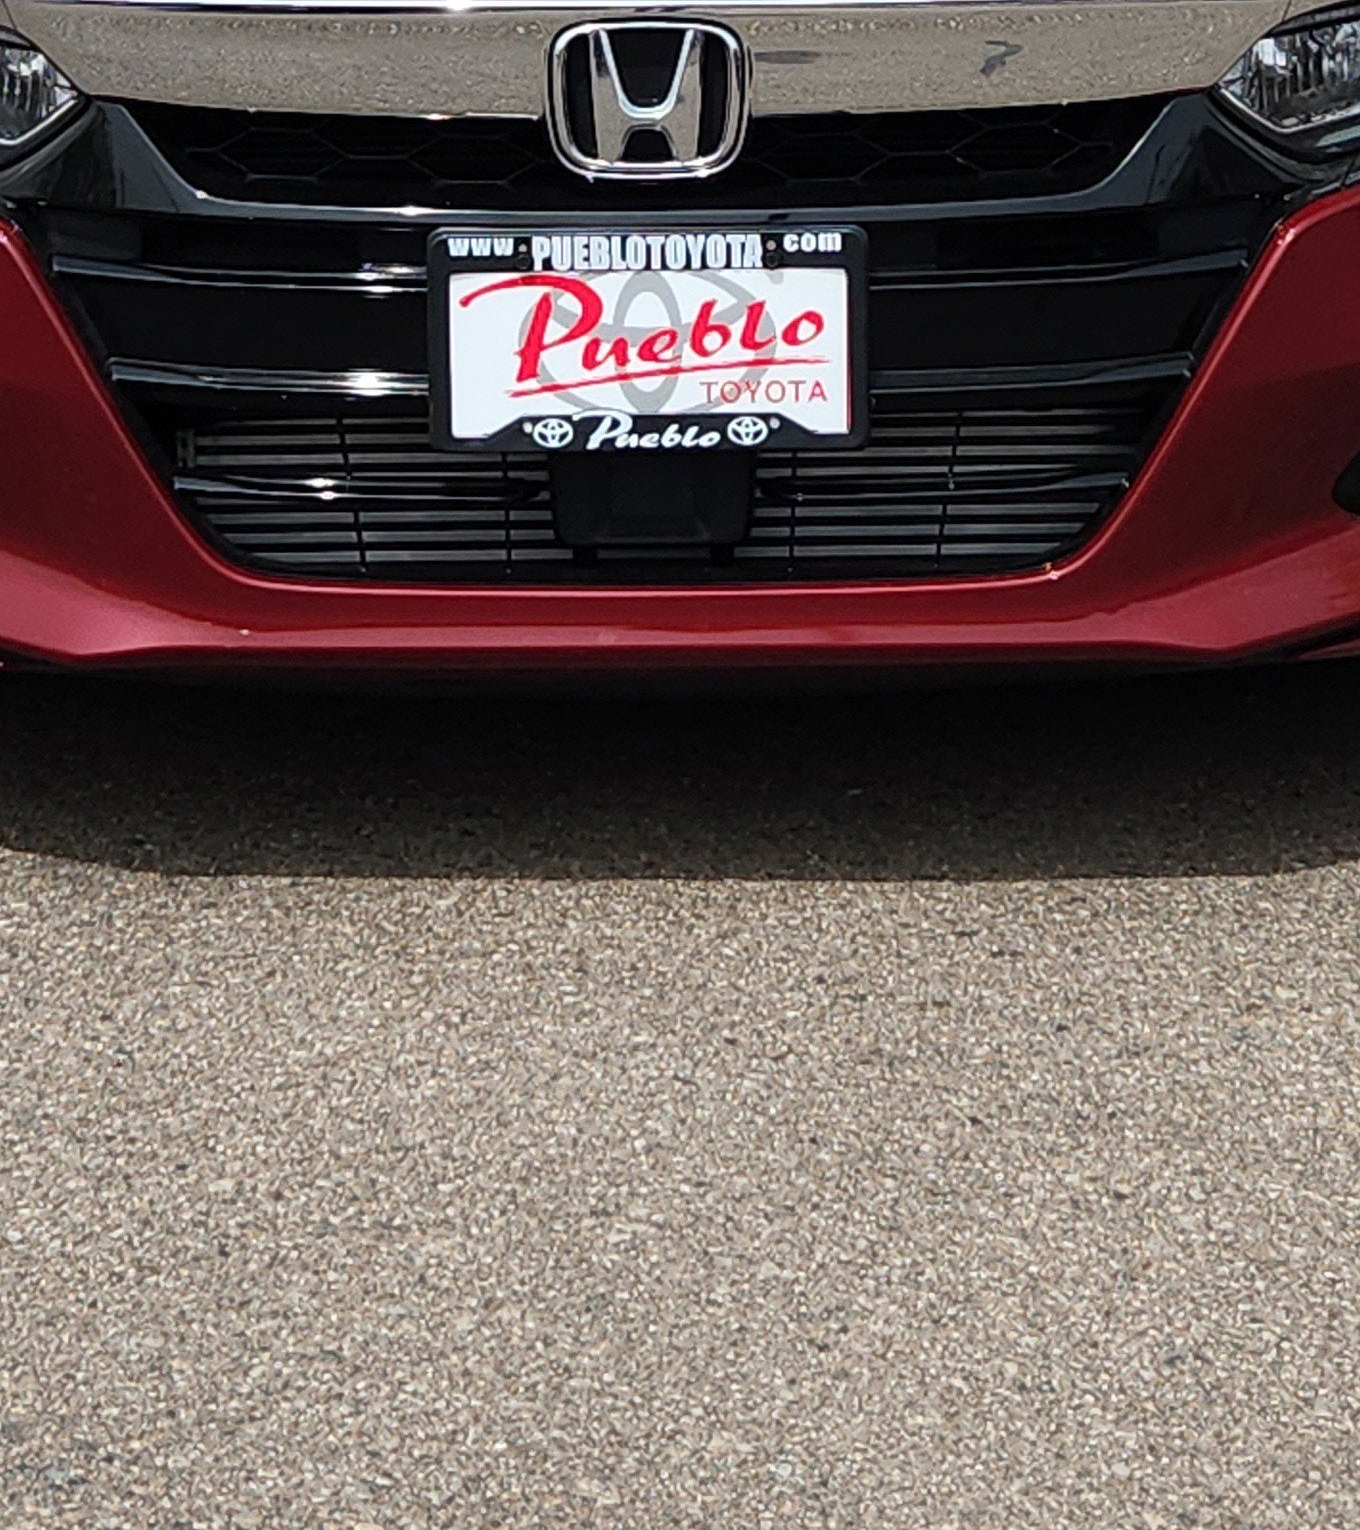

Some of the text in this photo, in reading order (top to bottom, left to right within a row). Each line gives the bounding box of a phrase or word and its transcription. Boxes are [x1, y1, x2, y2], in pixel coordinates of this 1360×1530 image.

[447, 237, 515, 257] www
[531, 233, 763, 271] PUEBLOTOYOTA
[459, 274, 825, 384] Pueblo
[700, 379, 828, 404] TOYOTA
[571, 408, 722, 451] Pueblo
